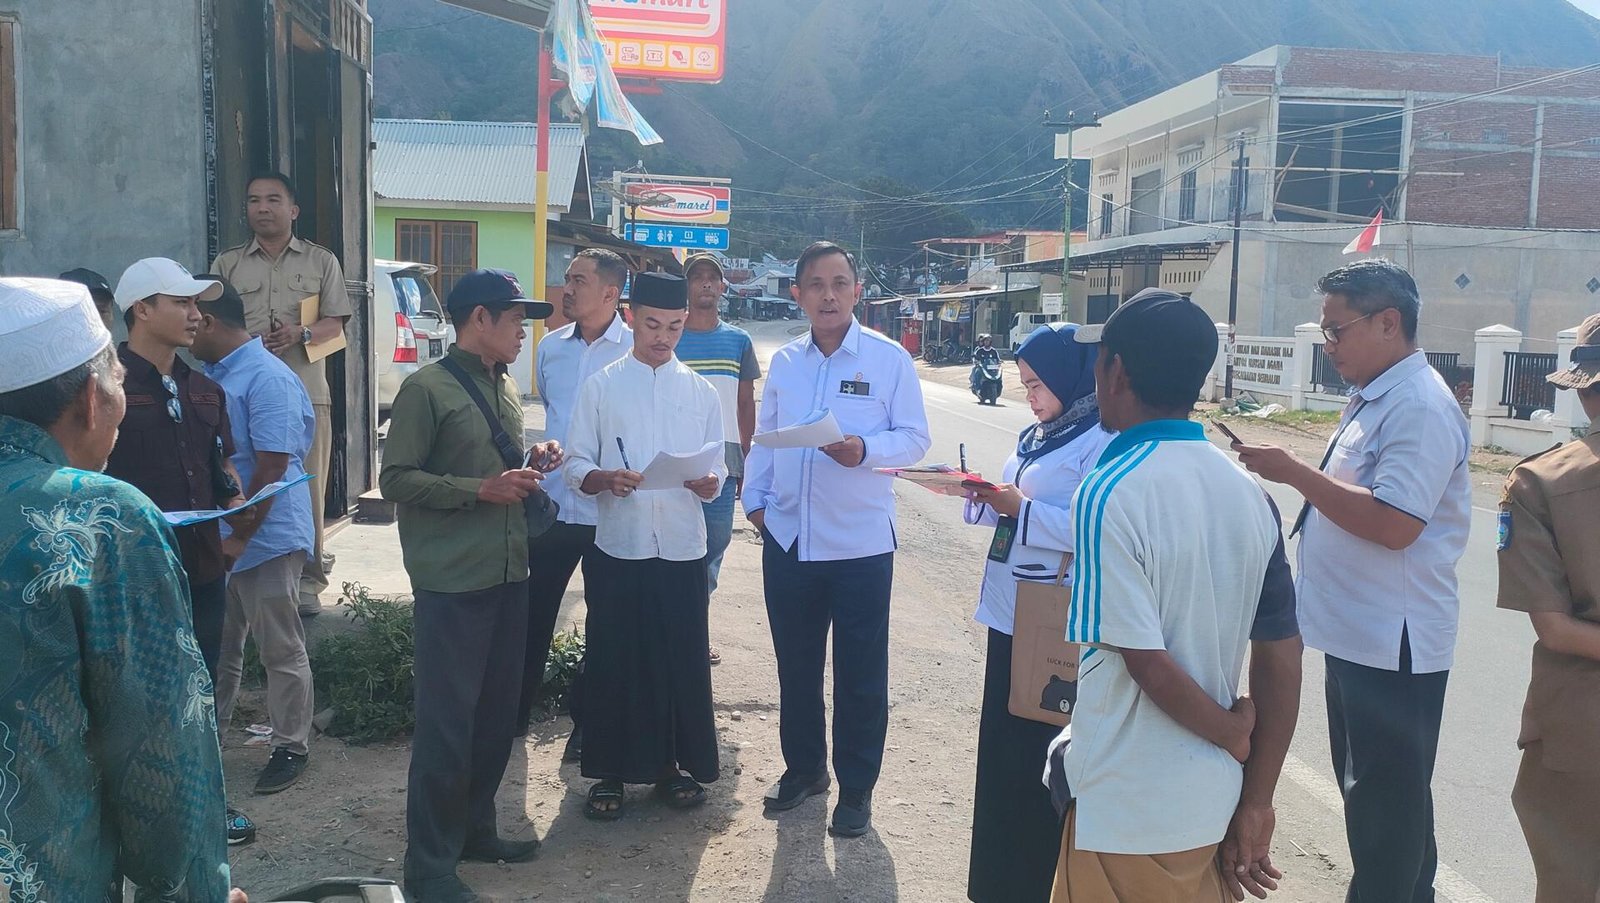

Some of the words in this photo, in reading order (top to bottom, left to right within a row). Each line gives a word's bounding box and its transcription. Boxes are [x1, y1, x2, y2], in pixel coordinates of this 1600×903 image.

[1282, 347, 1293, 358] HAJI
[1267, 360, 1283, 371] AGAMA
[1047, 657, 1061, 665] LUCK
[1063, 660, 1075, 669] FOR
